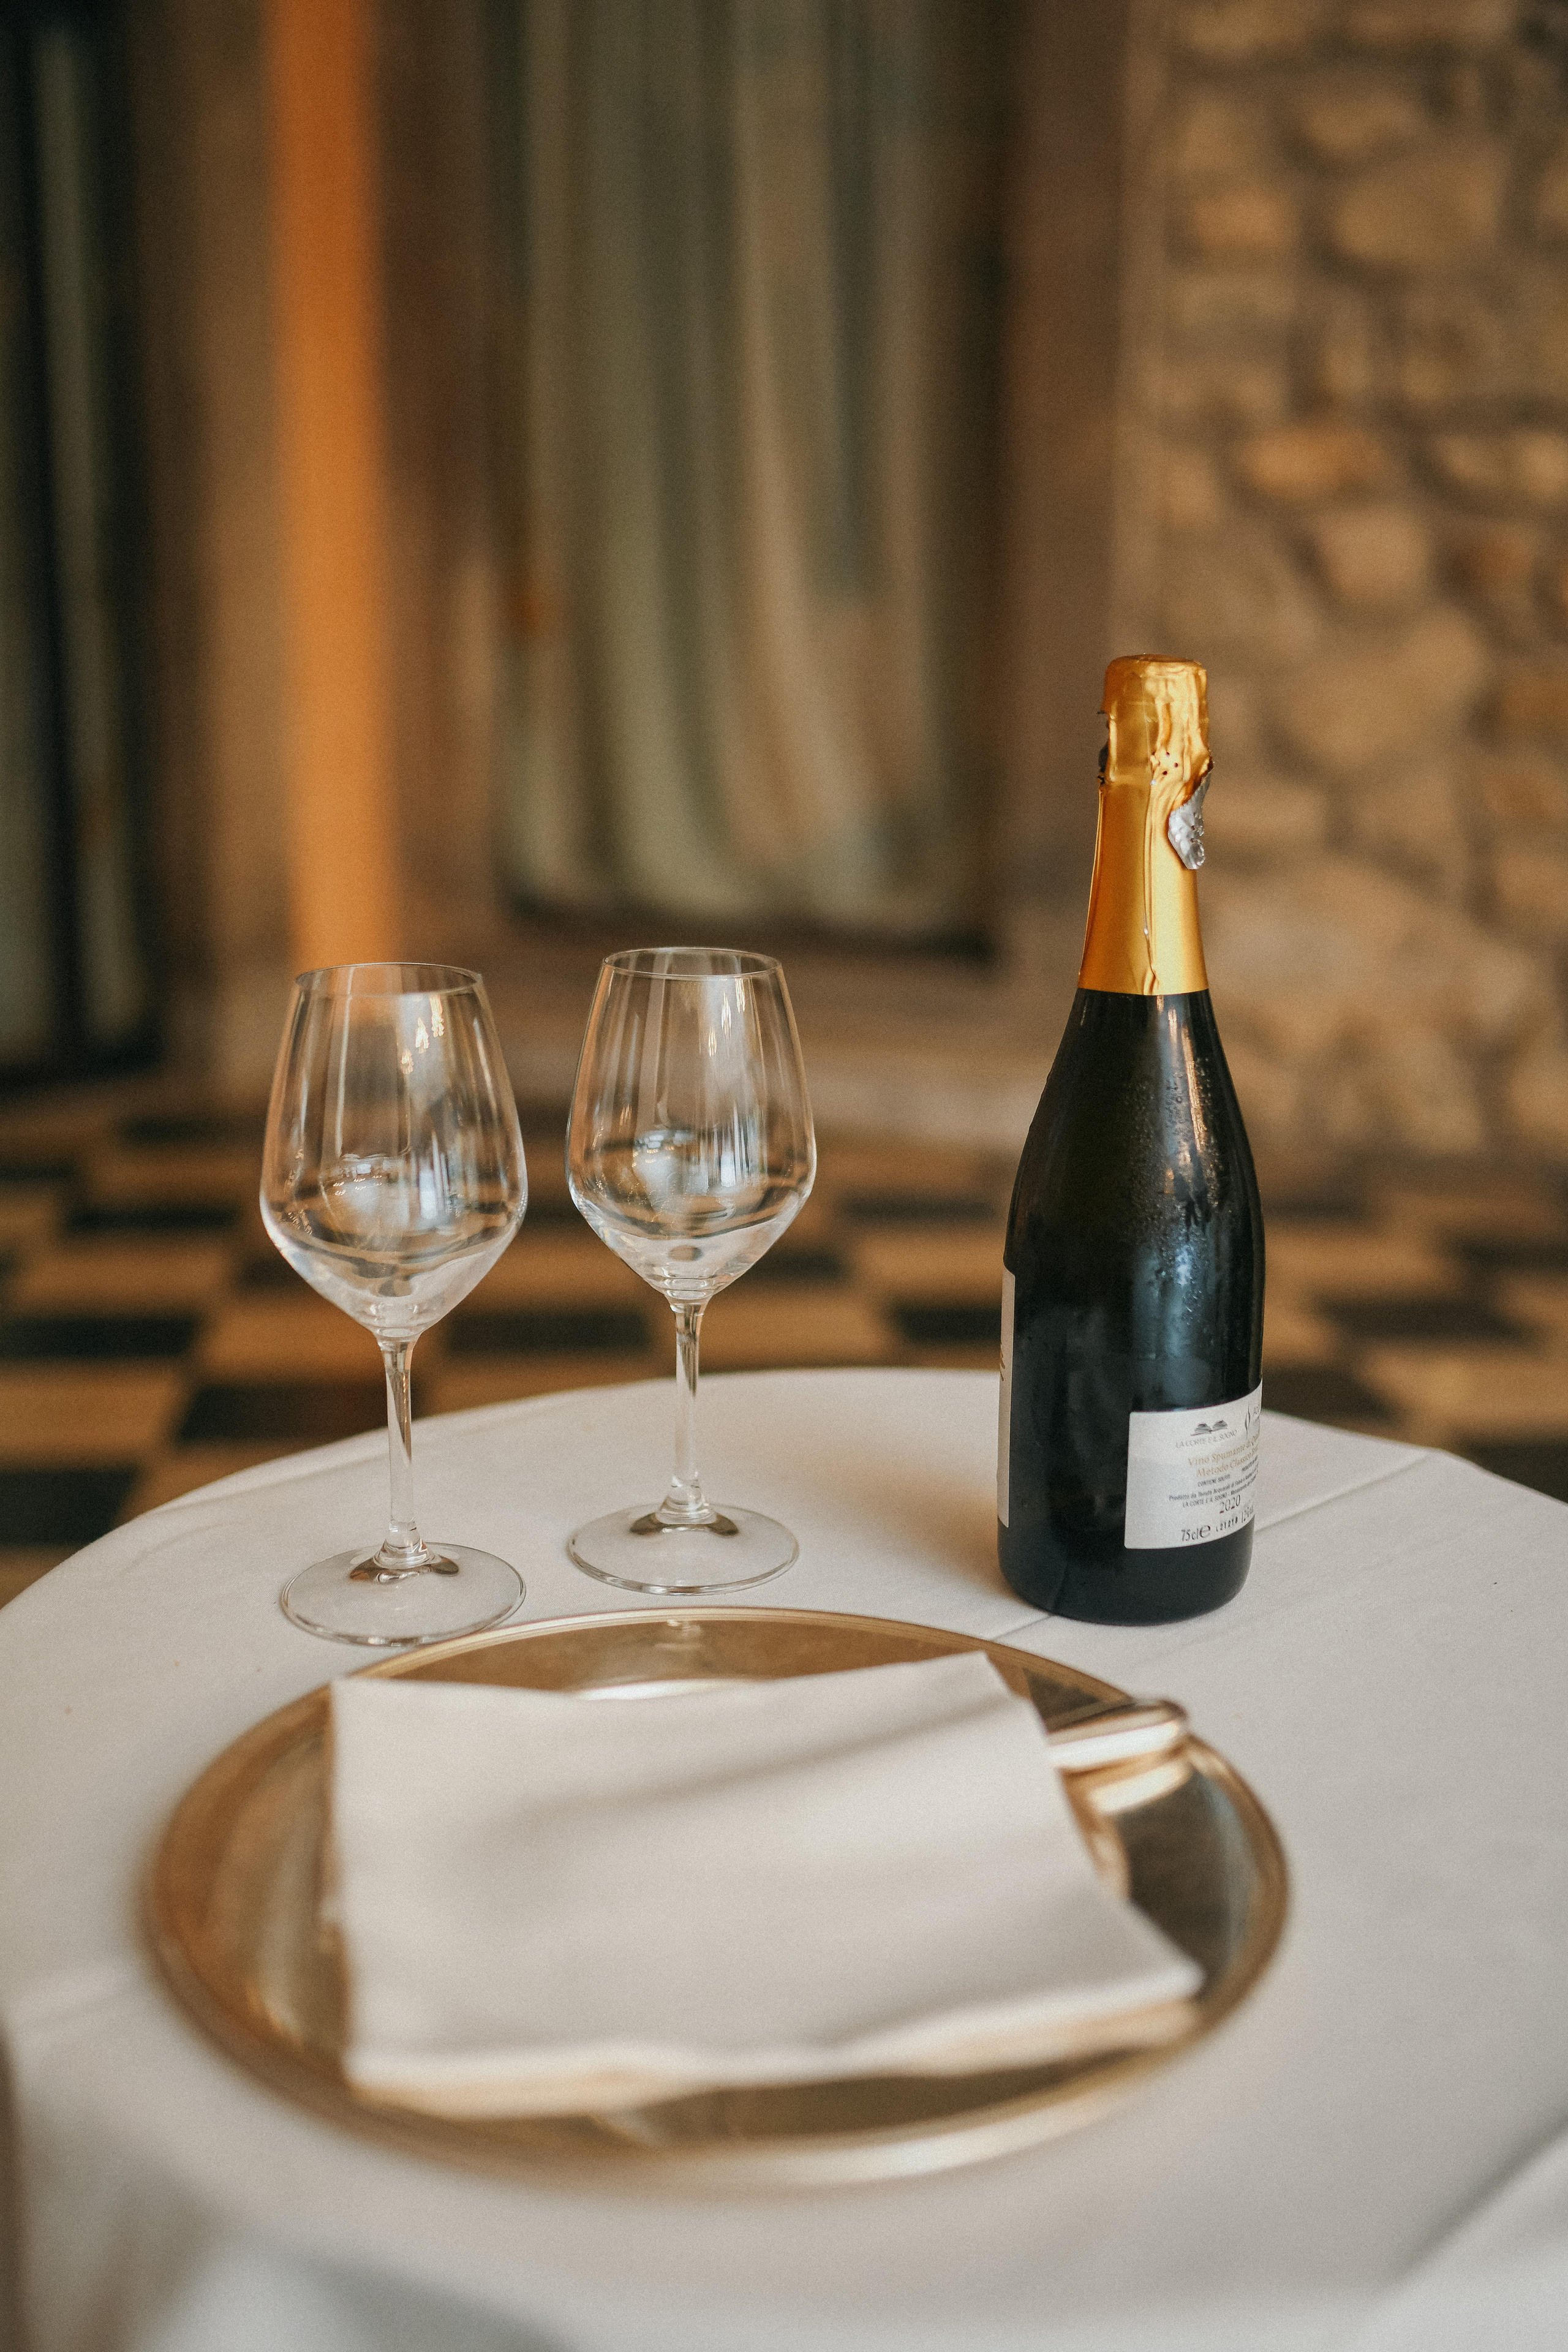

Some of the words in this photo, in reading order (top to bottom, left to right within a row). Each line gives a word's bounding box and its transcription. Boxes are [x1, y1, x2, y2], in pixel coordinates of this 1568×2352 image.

[1188, 1456, 1210, 1466] Vino
[1212, 1444, 1246, 1463] Spumante
[1197, 1463, 1229, 1477] Metodo
[1230, 1452, 1252, 1469] Classico
[1219, 1494, 1241, 1514] 2020
